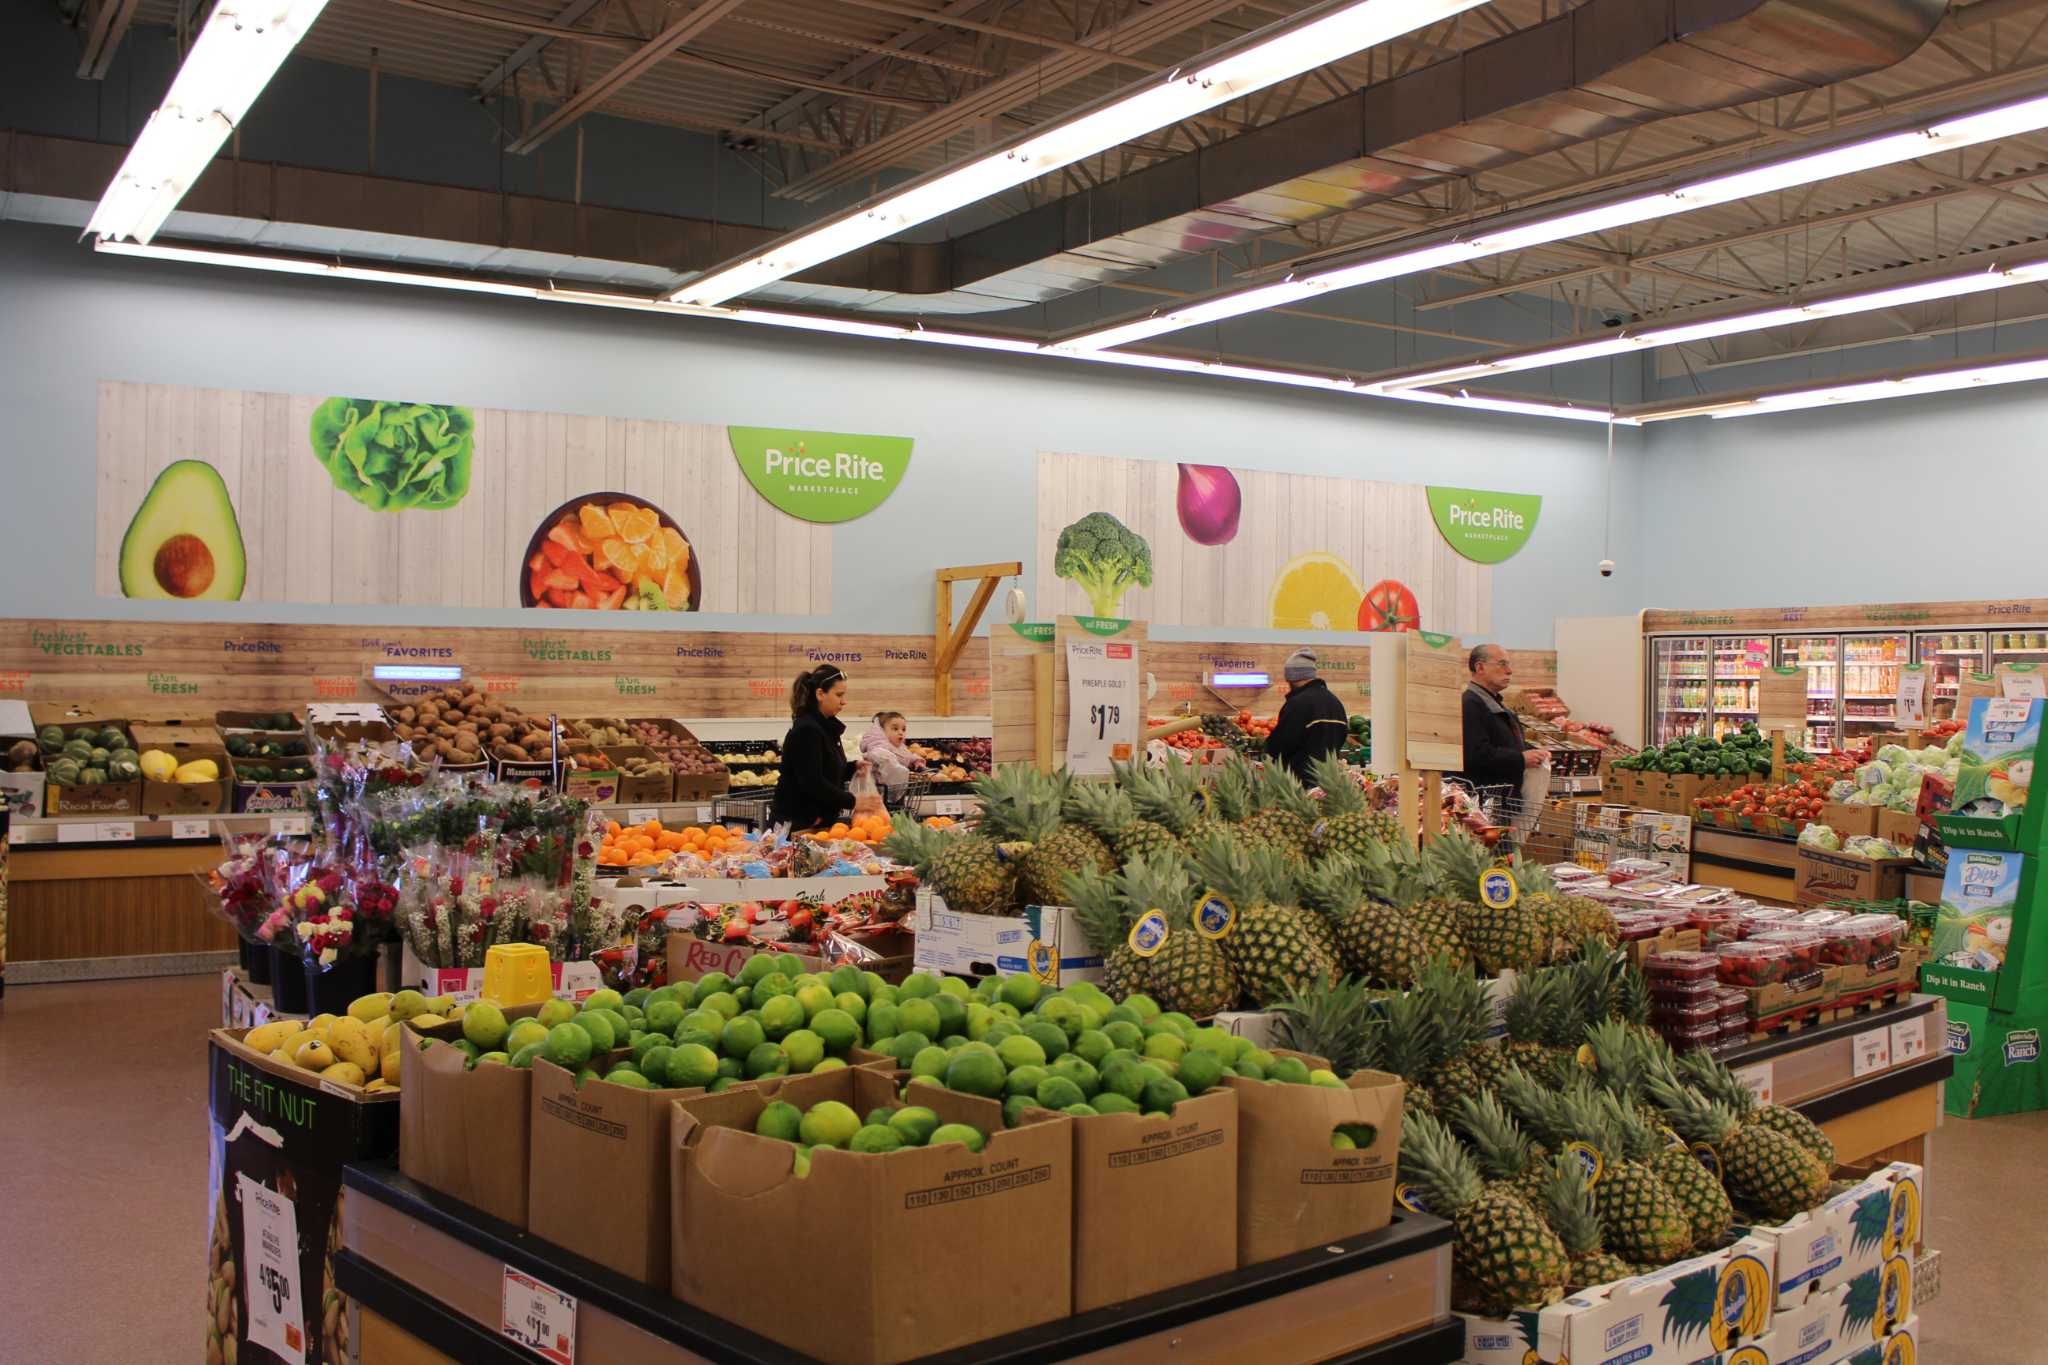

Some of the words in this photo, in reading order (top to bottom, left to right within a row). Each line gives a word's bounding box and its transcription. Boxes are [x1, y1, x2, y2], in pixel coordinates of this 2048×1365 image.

[789, 484, 859, 496] MARKETPLACE
[1096, 620, 1119, 630] FRESH
[42, 643, 143, 656] VEGETABLES
[387, 648, 453, 658] FAVORITES
[530, 650, 612, 661] VEGETABLES
[809, 652, 862, 663] FAVORITES
[1214, 660, 1256, 669] FAVORITES
[152, 683, 199, 694] FRESH
[319, 686, 358, 697] FRUIT
[619, 685, 656, 695] FRESH
[685, 941, 722, 974] RED
[1926, 974, 1942, 986] Dip
[1949, 977, 1960, 988] in
[1960, 979, 1987, 992] Ranch
[2008, 1046, 2037, 1059] Ranch
[227, 1063, 252, 1103] THE
[254, 1079, 275, 1114] FIT
[279, 1088, 317, 1130] NUT
[989, 1157, 1019, 1174] COUNT
